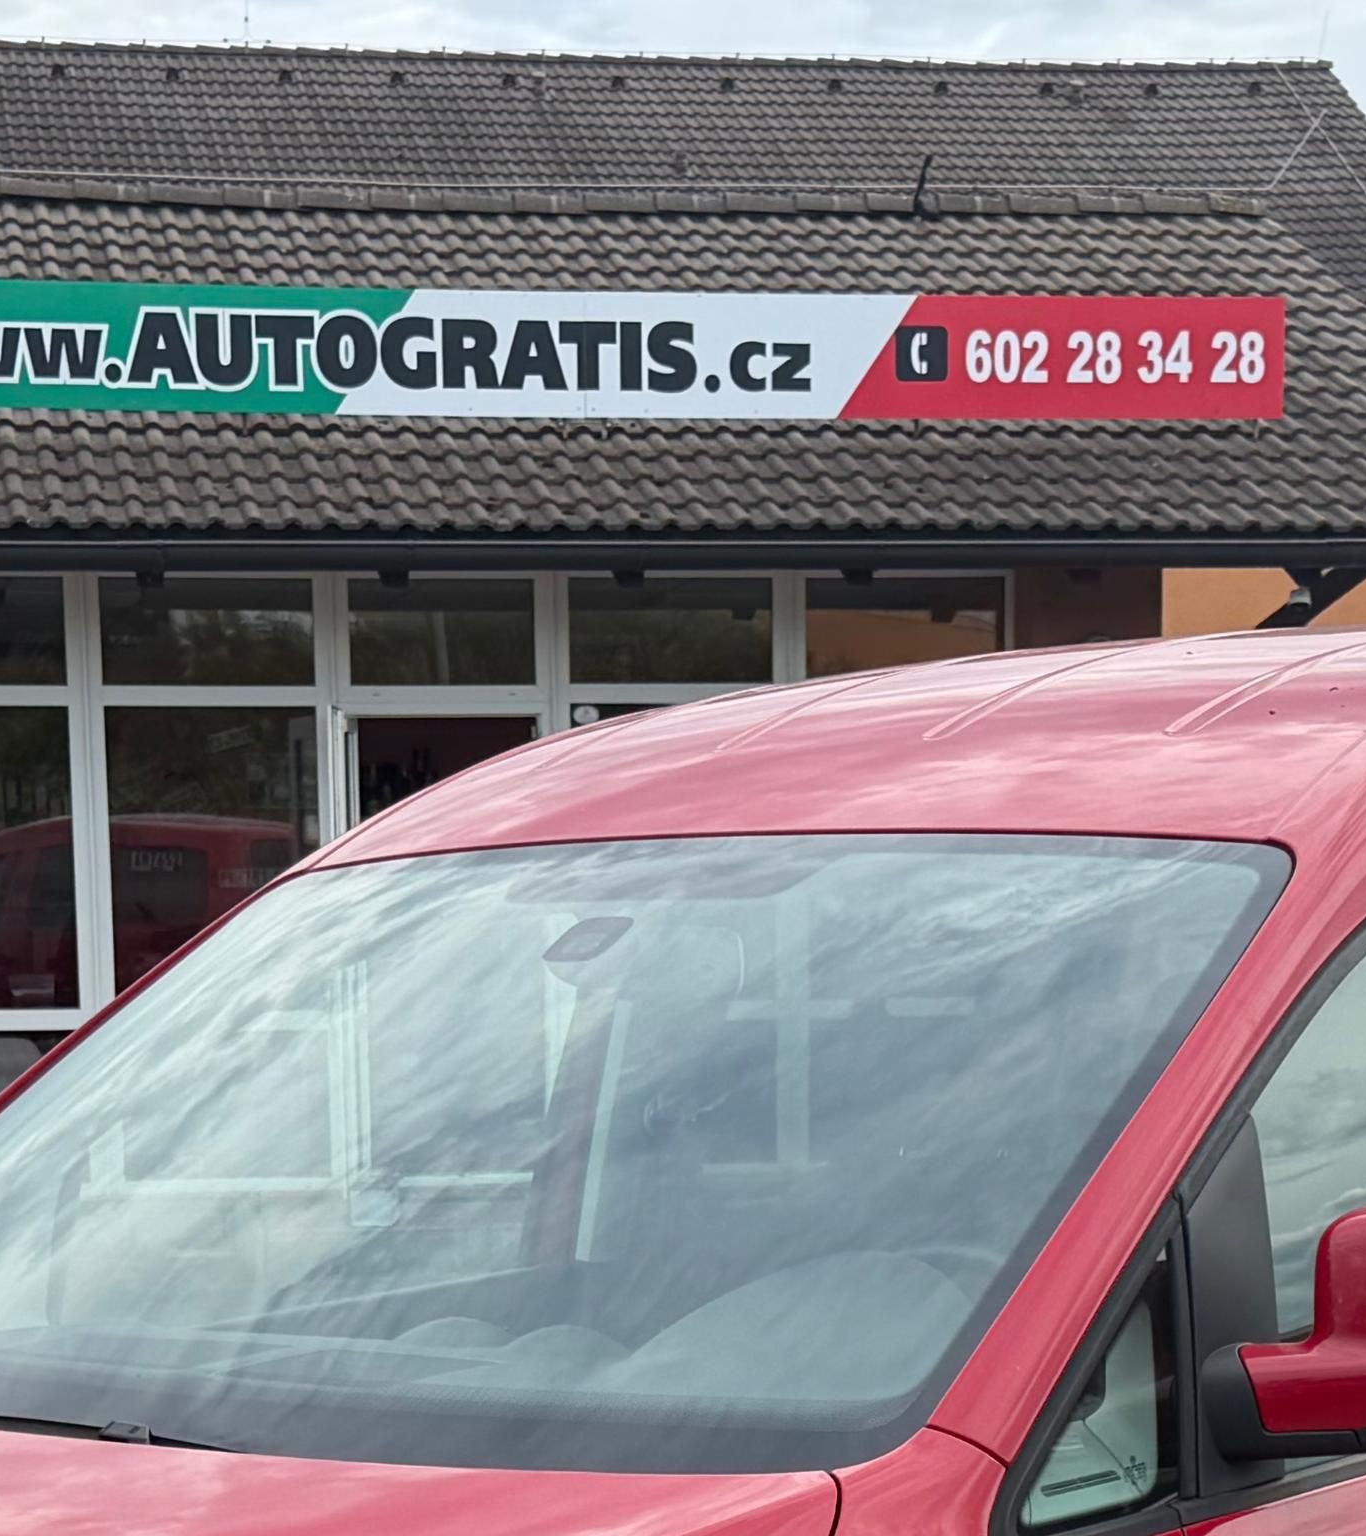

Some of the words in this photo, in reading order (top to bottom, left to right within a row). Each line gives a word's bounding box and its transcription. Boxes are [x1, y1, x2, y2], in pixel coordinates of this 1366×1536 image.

[965, 330, 1049, 384] 602
[1066, 330, 1123, 384] 28
[1137, 330, 1193, 384] 34
[1210, 330, 1266, 384] 28
